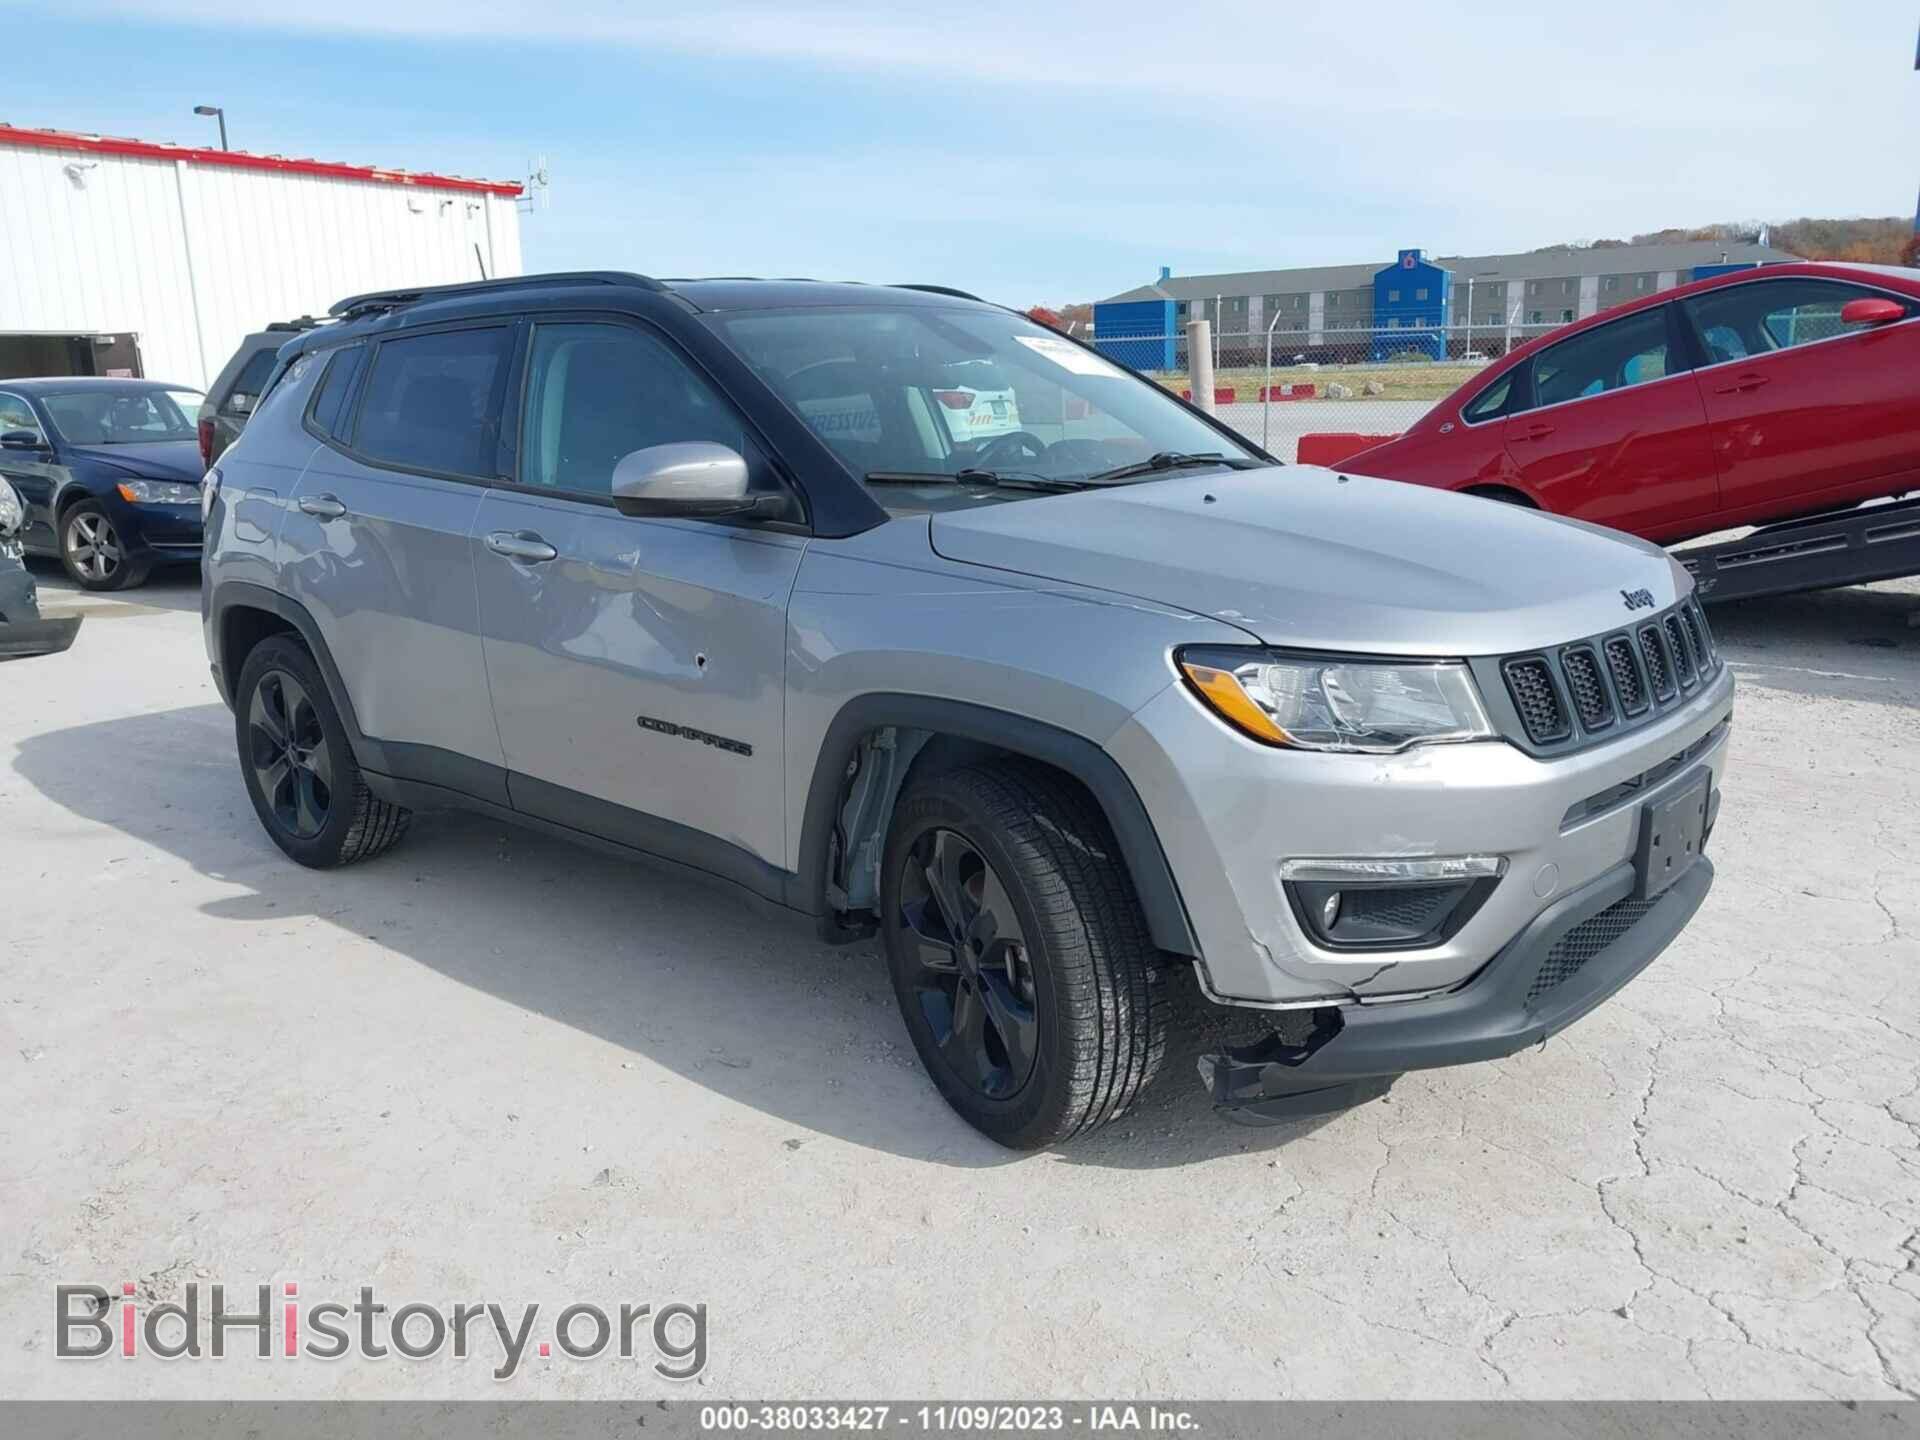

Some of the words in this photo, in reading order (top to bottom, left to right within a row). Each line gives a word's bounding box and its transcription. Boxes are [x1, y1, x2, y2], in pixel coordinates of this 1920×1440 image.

[1403, 252, 1416, 269] 6
[1620, 589, 1655, 610] Jeep
[637, 716, 753, 757] COMPASS
